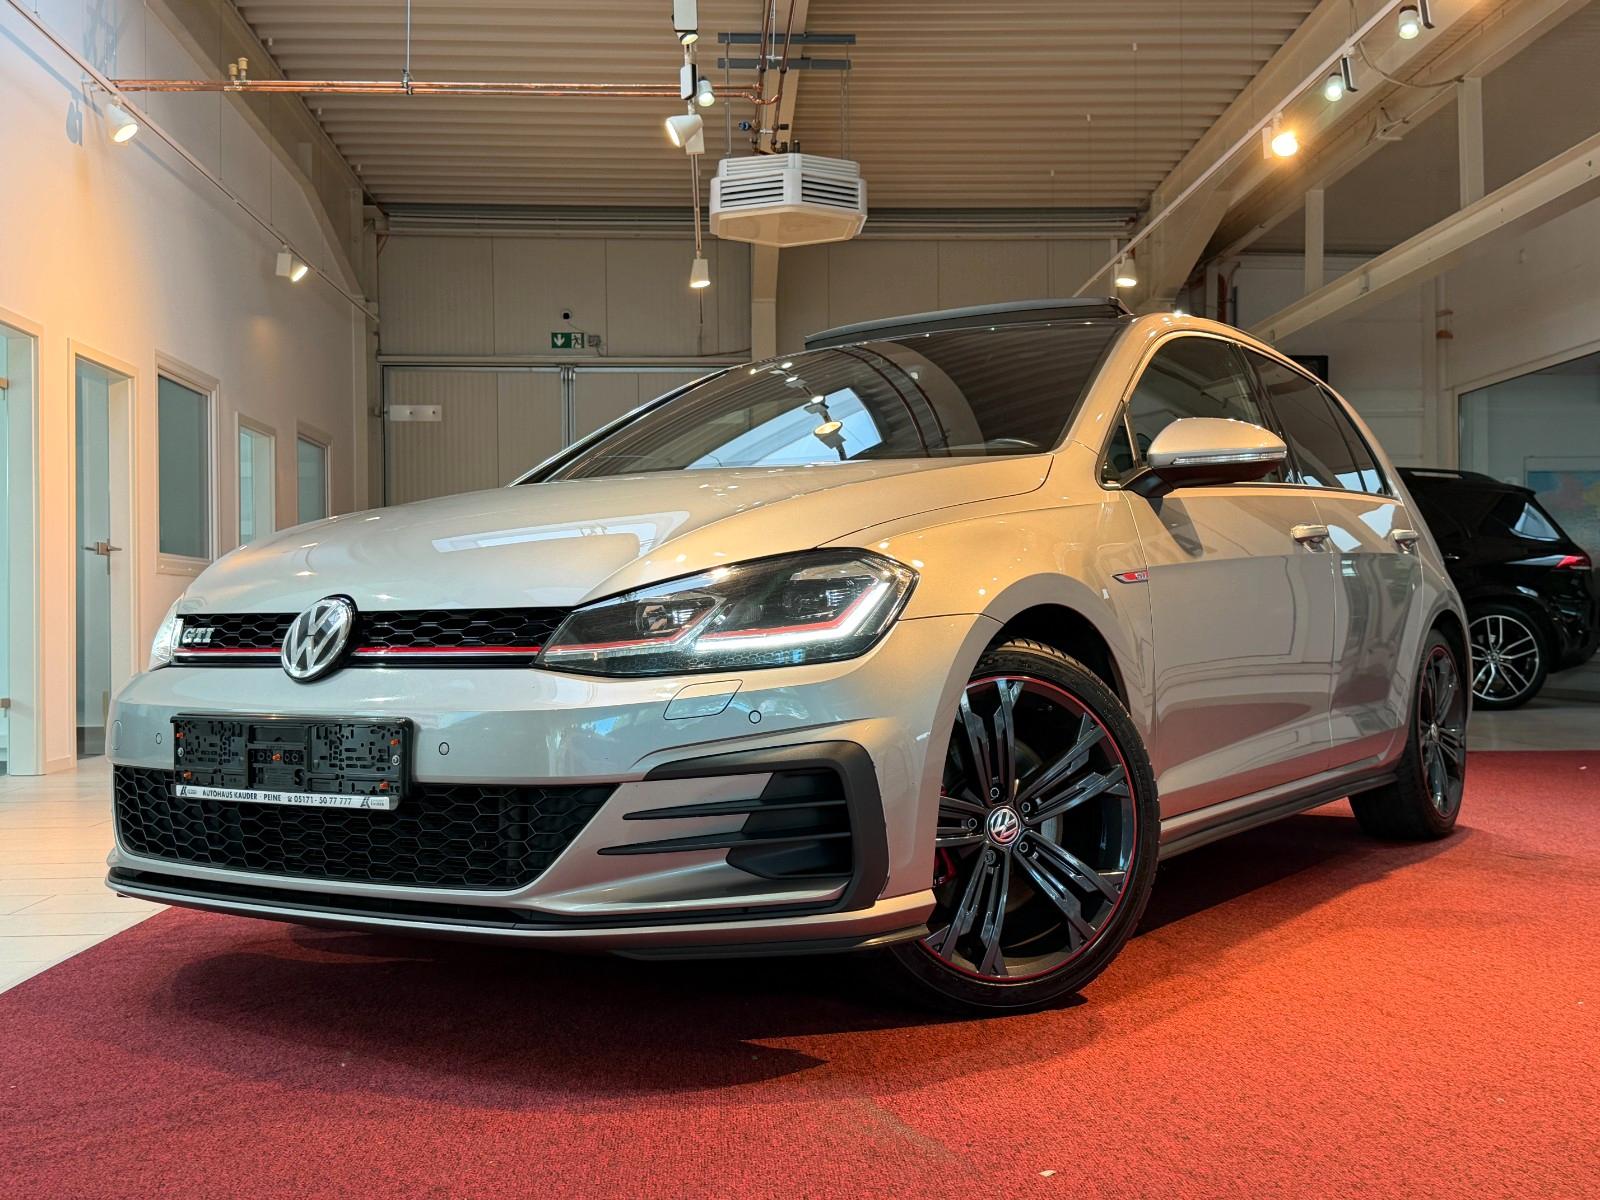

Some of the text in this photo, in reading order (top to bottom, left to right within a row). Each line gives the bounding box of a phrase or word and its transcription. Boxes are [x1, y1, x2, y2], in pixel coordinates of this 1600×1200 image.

[182, 627, 215, 644] GTI
[203, 789, 233, 799] AUTOHAUS
[234, 792, 258, 800] KAUDER
[263, 793, 282, 801] PEINE
[293, 795, 314, 803] 05171
[319, 796, 328, 805] 50
[329, 797, 338, 805] 77
[339, 797, 353, 805] 777
